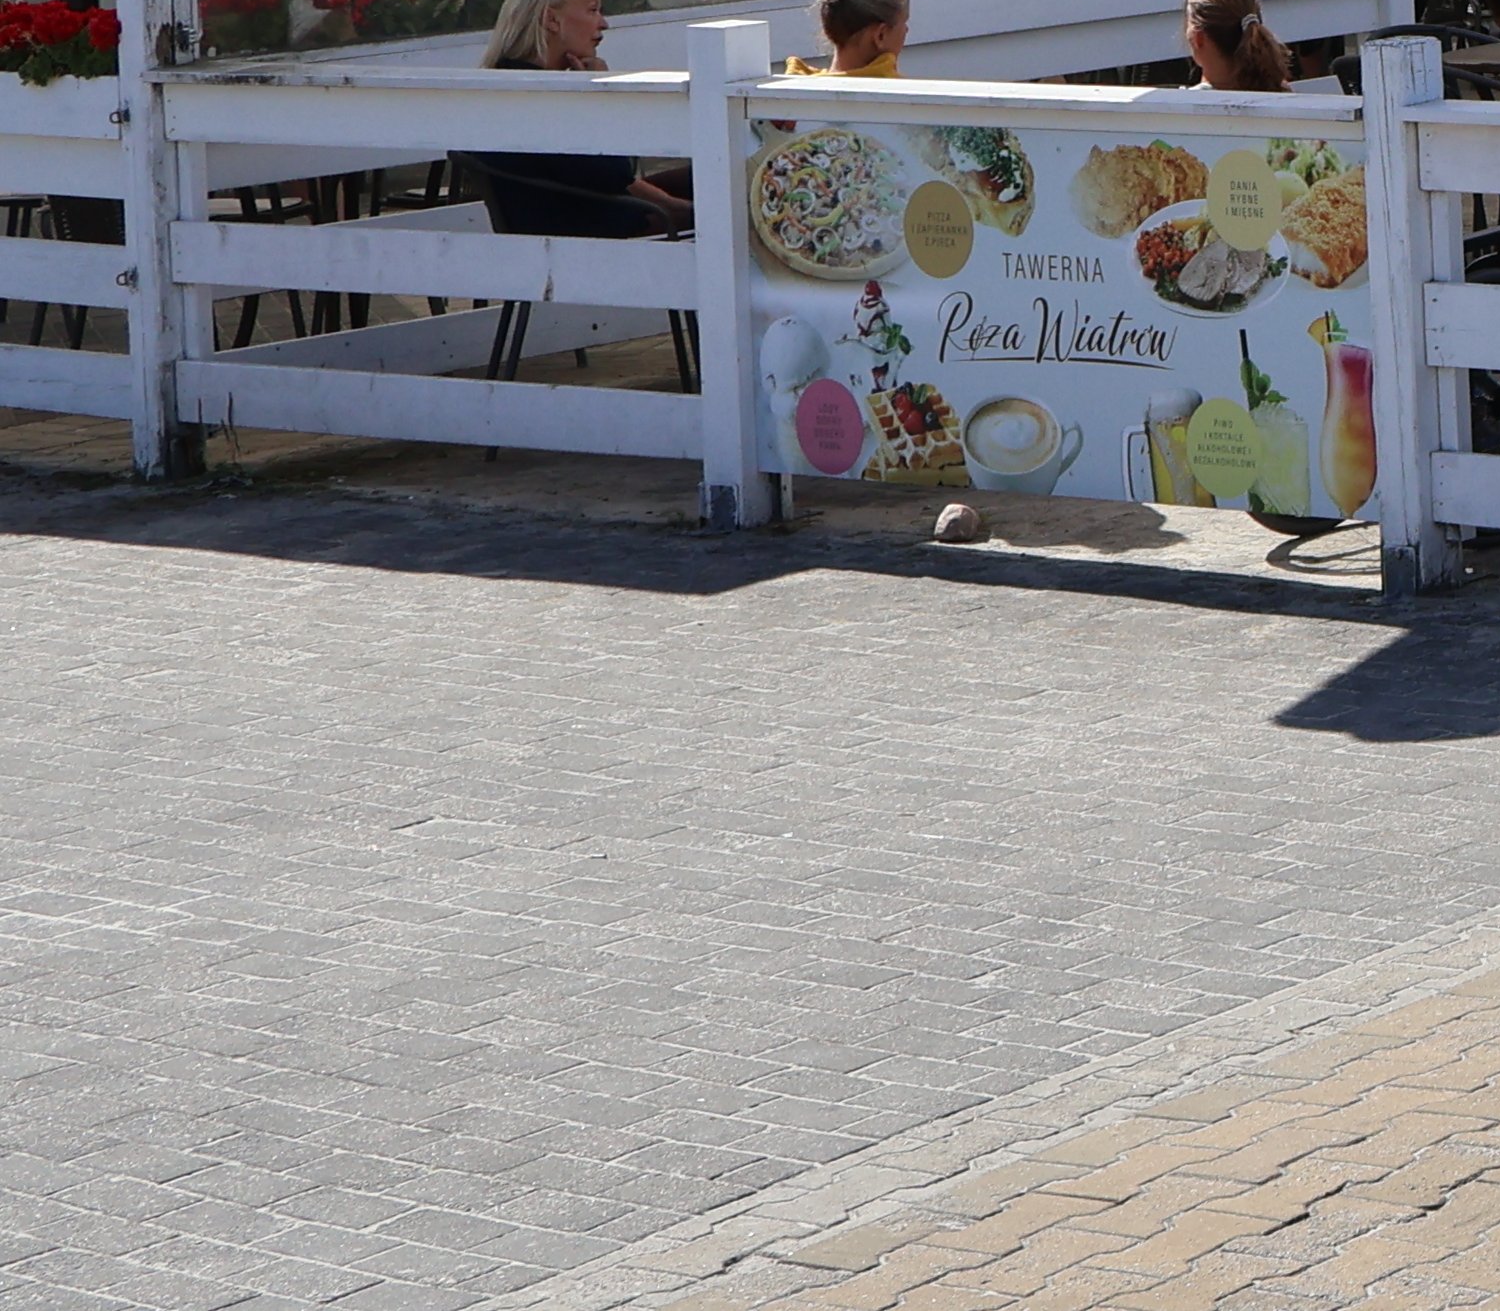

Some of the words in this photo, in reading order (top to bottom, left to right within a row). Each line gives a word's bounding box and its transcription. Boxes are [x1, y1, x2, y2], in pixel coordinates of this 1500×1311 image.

[1230, 180, 1258, 191] DANIA
[1230, 193, 1259, 205] RYBNE
[1231, 207, 1264, 220] MIĘSNE
[1002, 252, 1104, 284] TAWERNA
